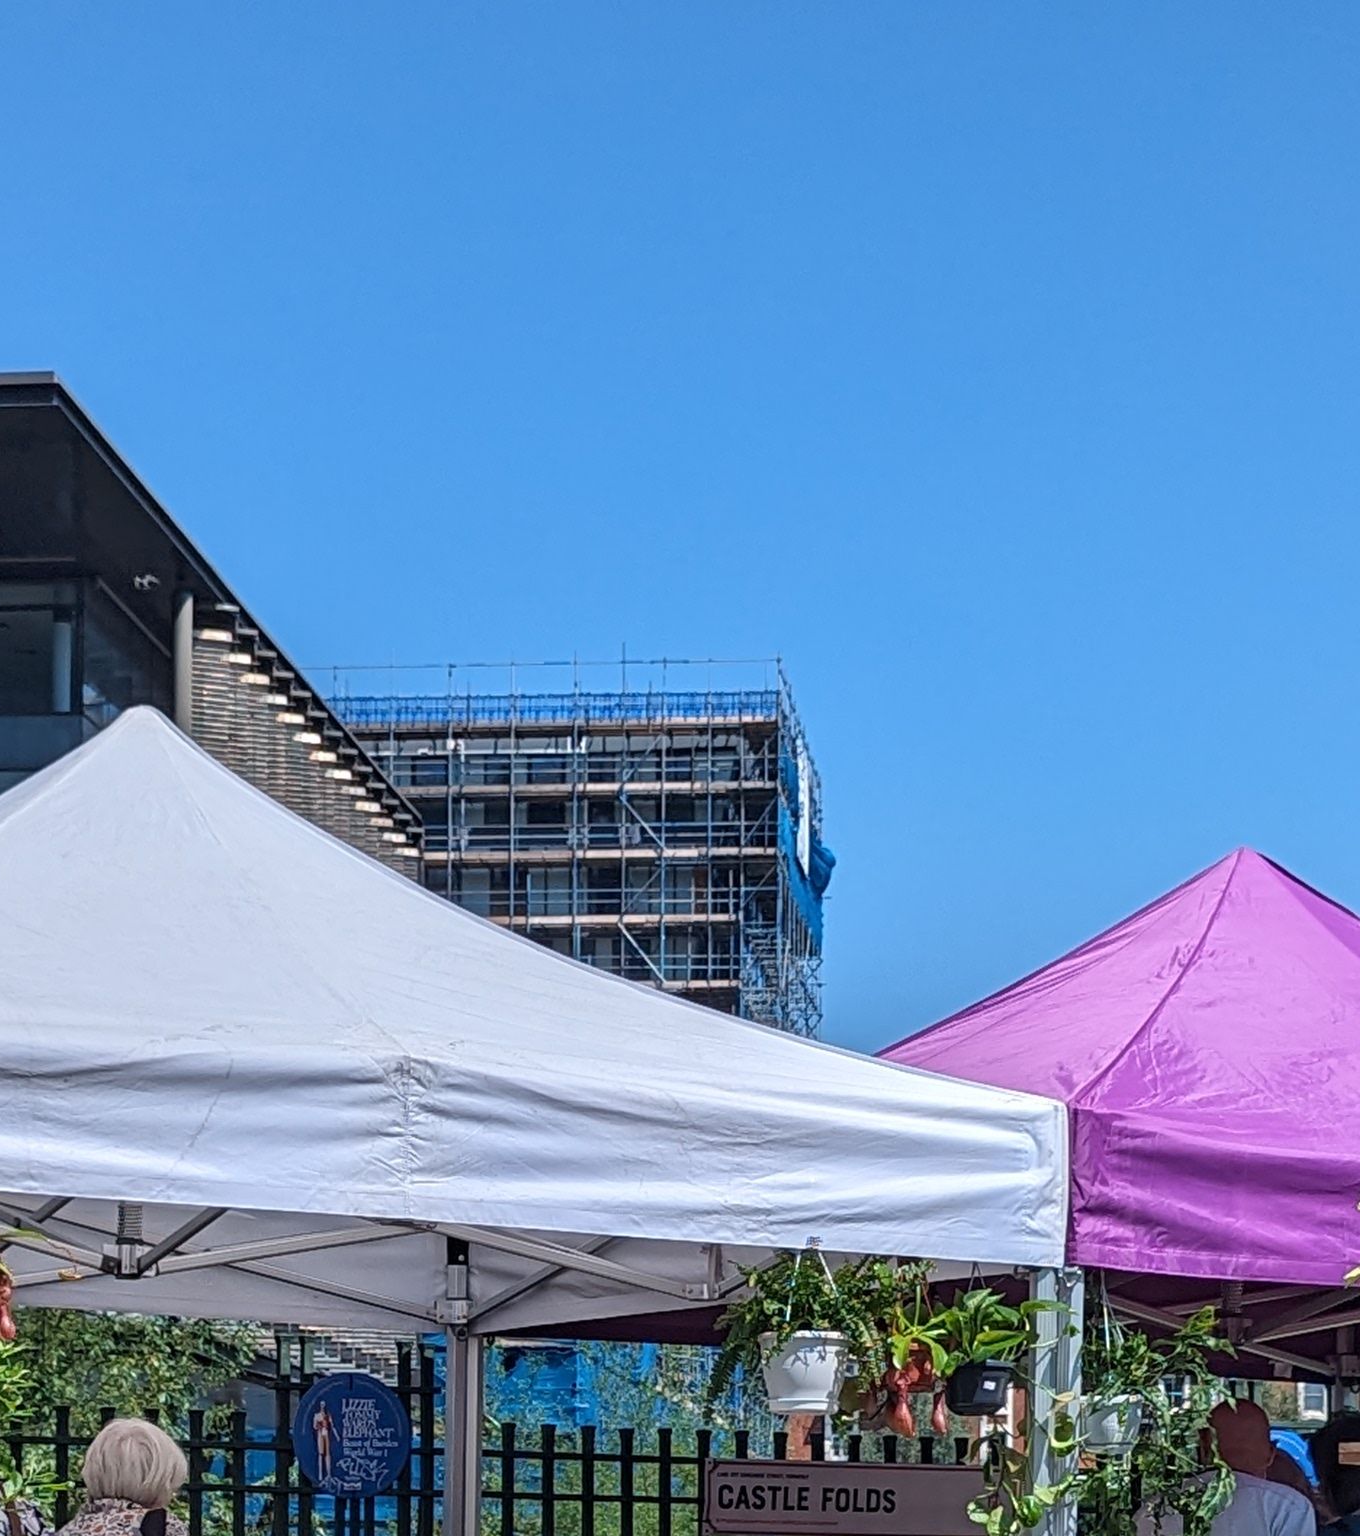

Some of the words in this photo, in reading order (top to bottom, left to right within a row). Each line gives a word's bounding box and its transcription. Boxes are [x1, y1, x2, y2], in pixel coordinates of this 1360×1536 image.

[341, 1398, 377, 1411] LIZZIE
[342, 1426, 395, 1438] ELEPHANT
[718, 1484, 810, 1511] CASTLE
[821, 1487, 896, 1514] FOLDS
